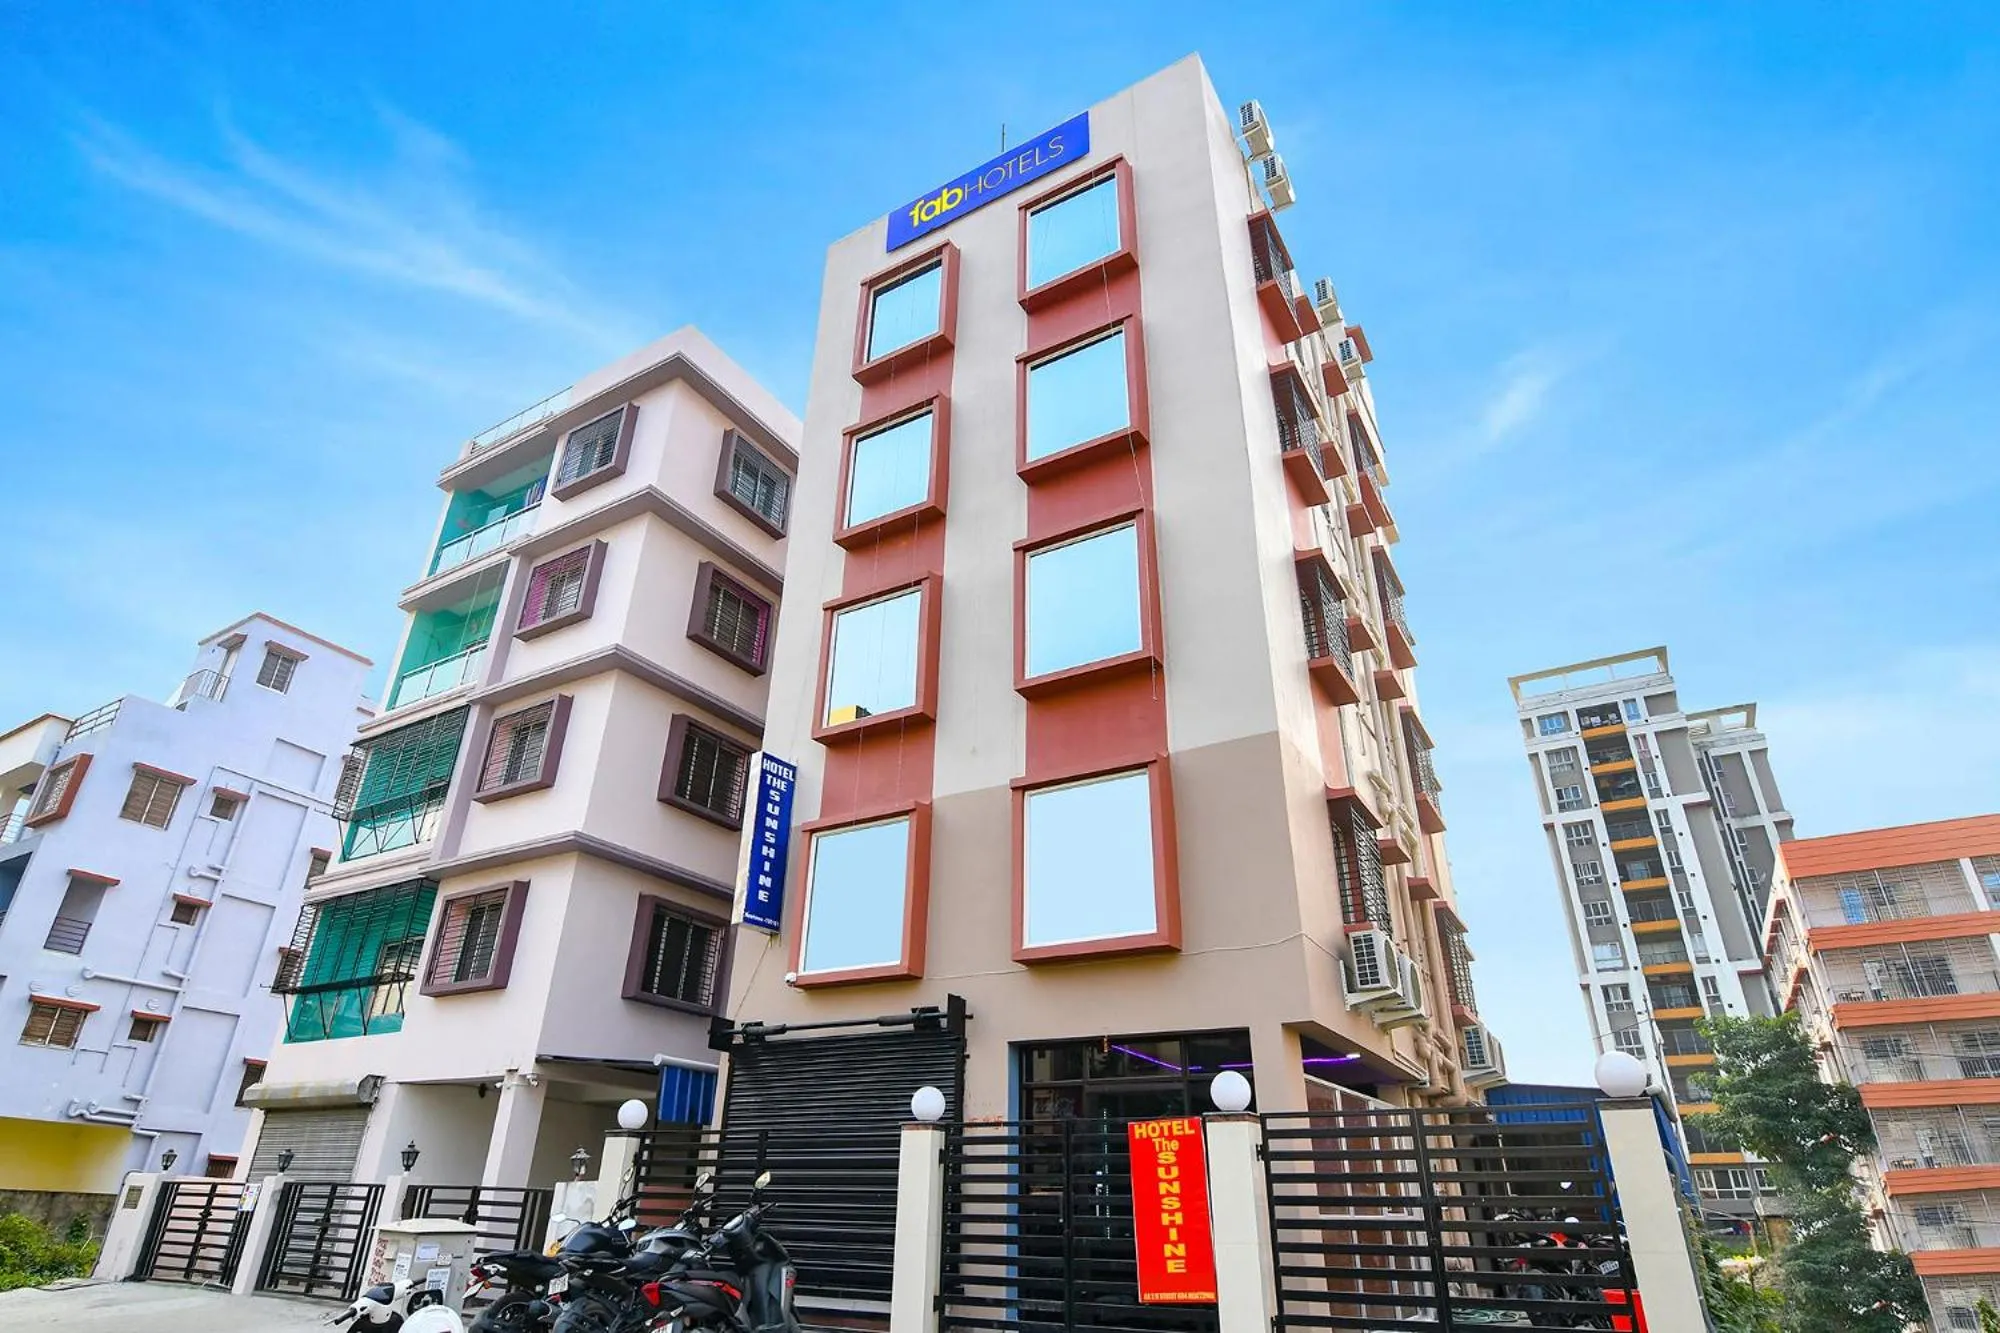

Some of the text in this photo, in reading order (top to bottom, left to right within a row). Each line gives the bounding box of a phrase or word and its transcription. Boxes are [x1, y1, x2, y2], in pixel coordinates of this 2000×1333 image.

[762, 757, 794, 782] HOTEL
[766, 774, 788, 792] THE
[758, 789, 781, 903] SUNSHINE
[1134, 1120, 1195, 1139] HOTEL
[1152, 1137, 1179, 1152] The
[1157, 1151, 1186, 1274] SUNSHINE
